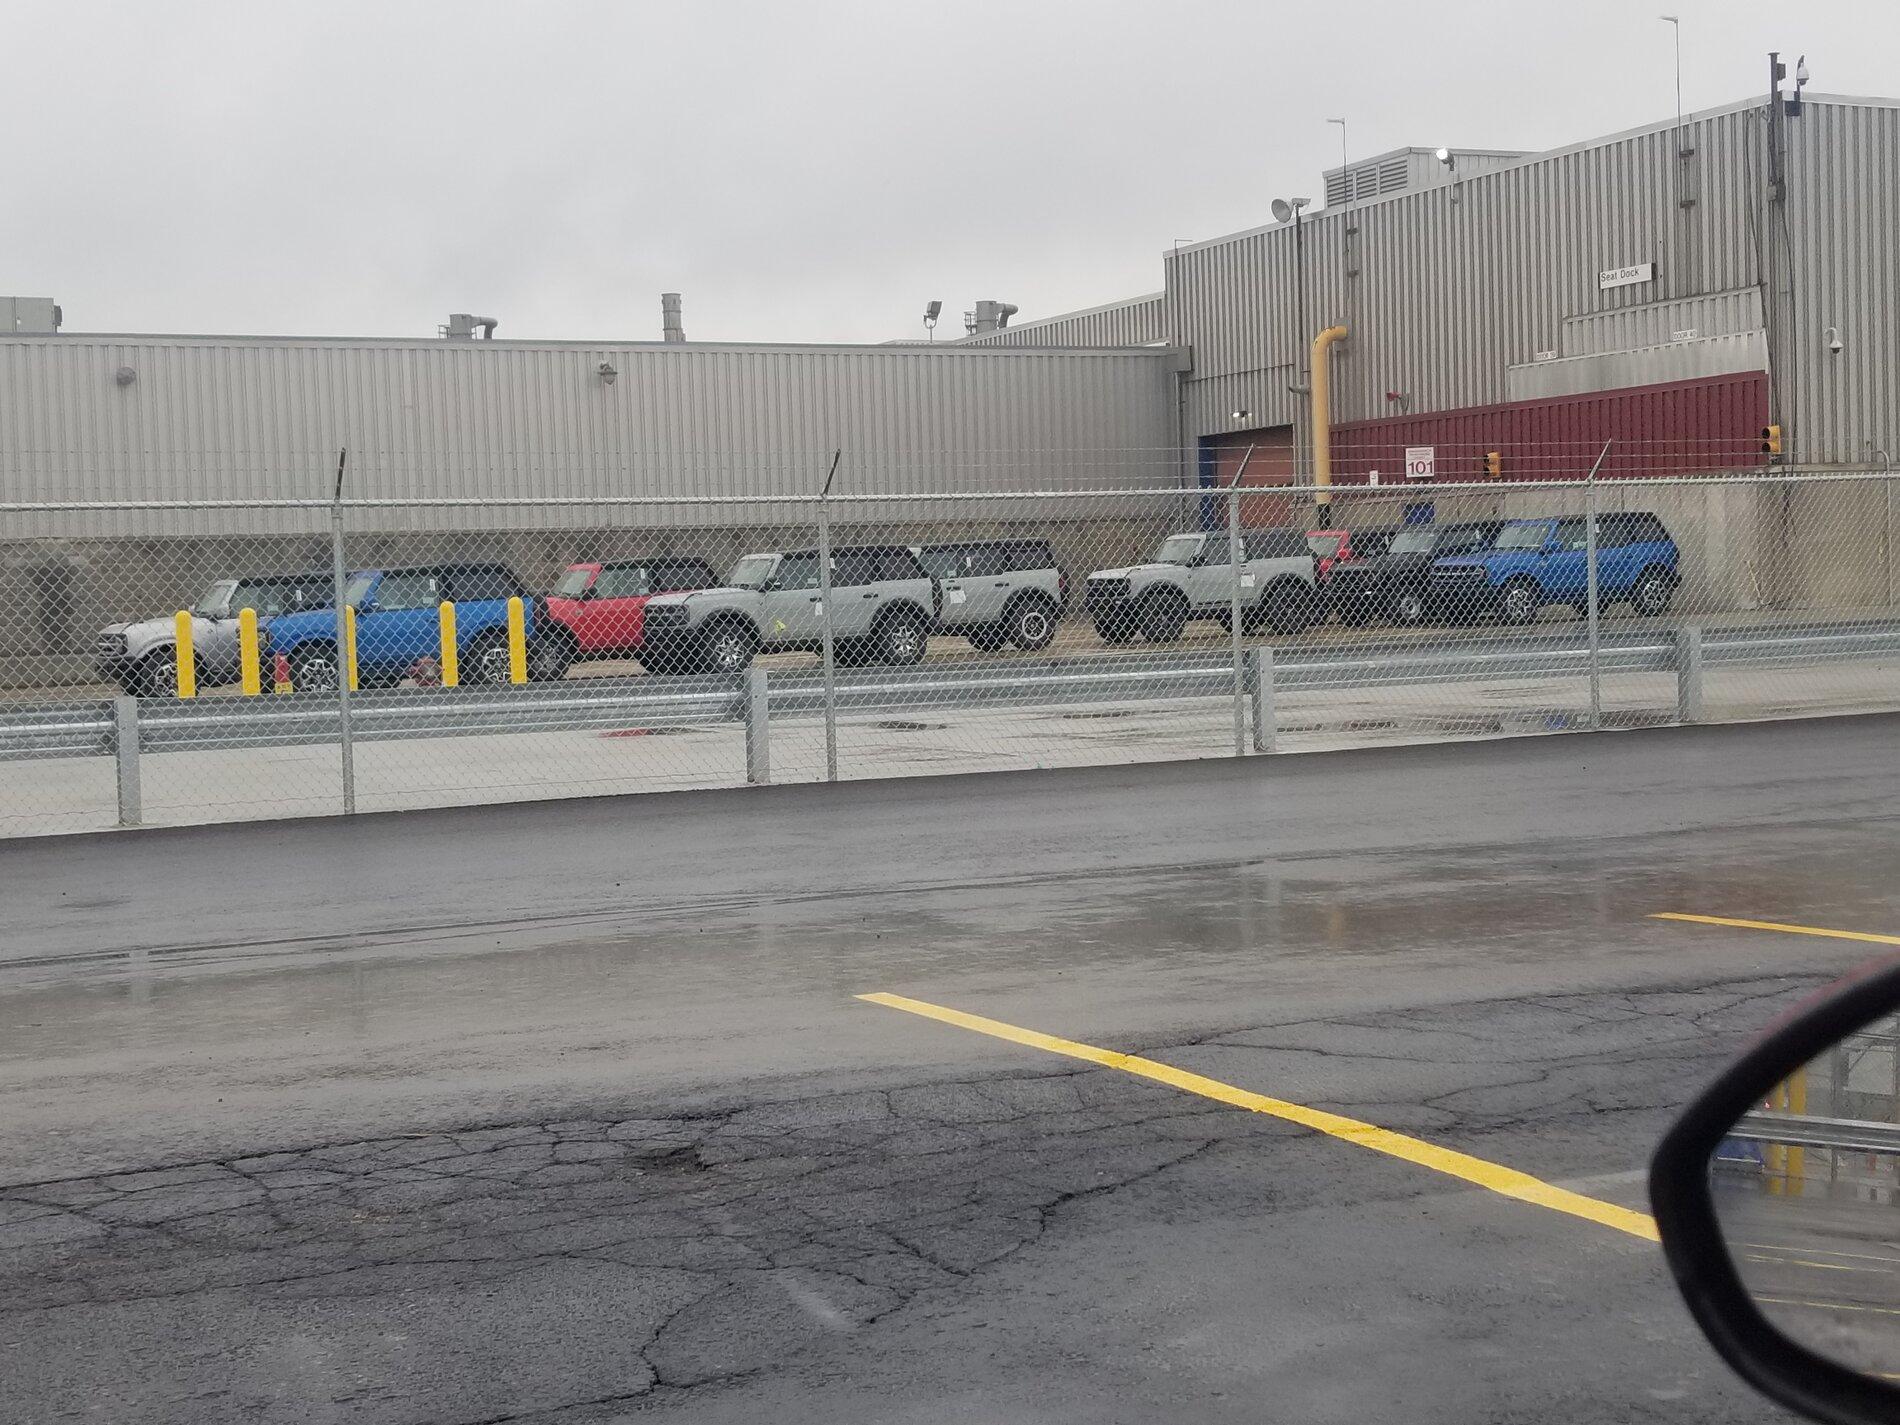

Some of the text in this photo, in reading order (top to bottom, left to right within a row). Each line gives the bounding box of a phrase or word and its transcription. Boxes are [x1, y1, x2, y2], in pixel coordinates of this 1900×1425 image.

[1600, 267, 1639, 282] Seat Dock
[1407, 460, 1433, 475] 101
